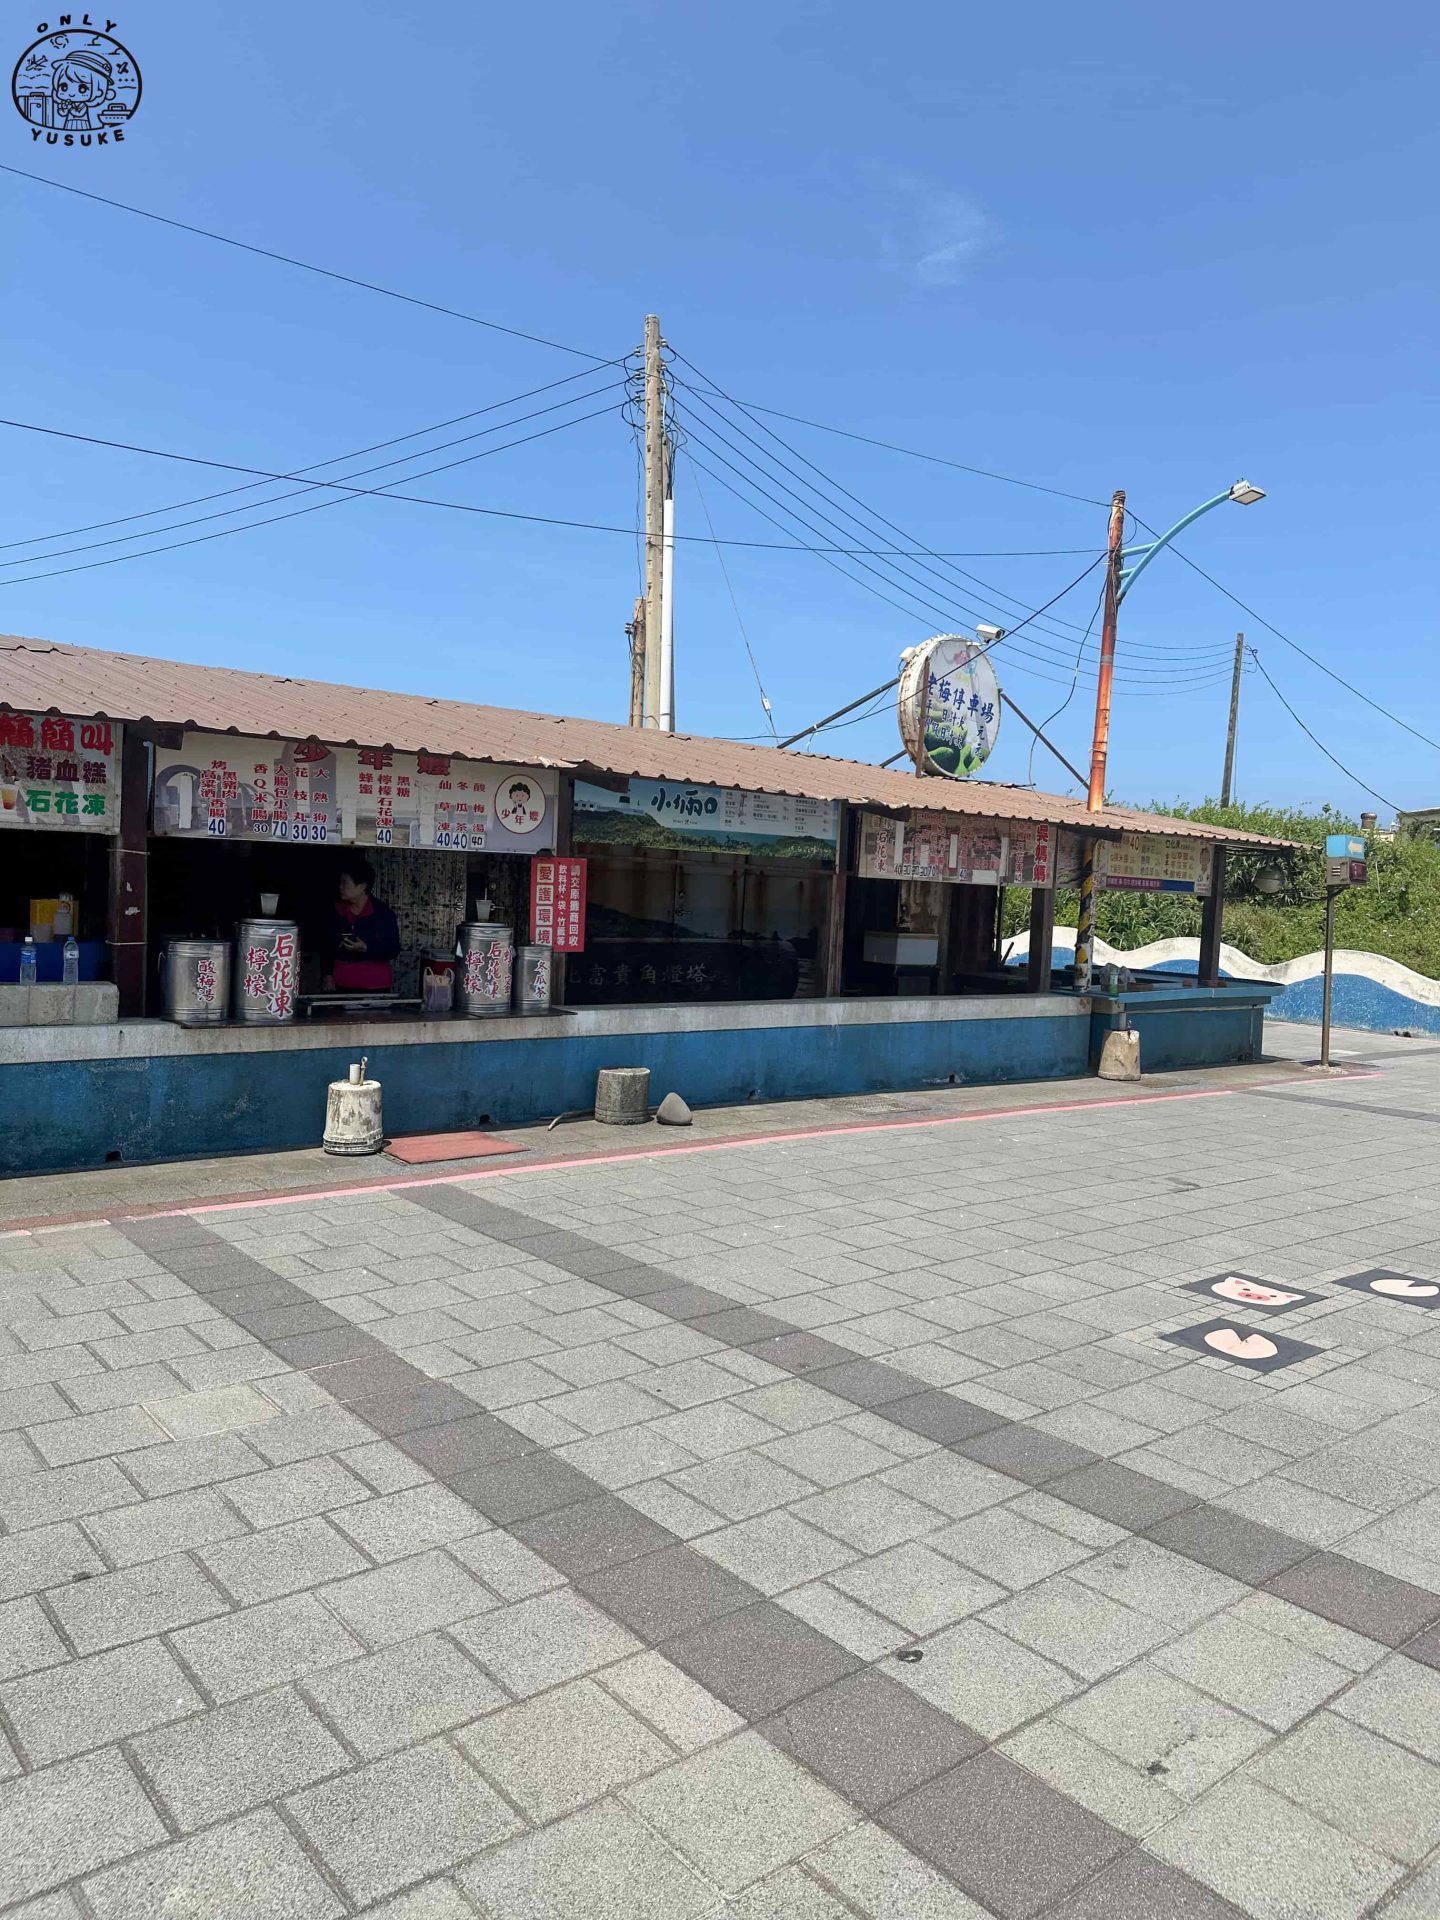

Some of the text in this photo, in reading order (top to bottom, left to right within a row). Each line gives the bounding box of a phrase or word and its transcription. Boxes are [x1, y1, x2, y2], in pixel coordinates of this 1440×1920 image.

[25, 789, 106, 816] 石花凍
[292, 767, 309, 823] 花枝丸
[455, 781, 469, 832] 冬瓜茶
[209, 818, 225, 834] 40
[254, 823, 268, 833] 30
[272, 821, 288, 837] 70
[292, 824, 308, 840] 30
[311, 825, 327, 841] 30
[377, 829, 392, 844] 40
[437, 832, 450, 846] 40
[453, 834, 468, 849] 40
[537, 866, 552, 944] 愛護環境
[197, 959, 217, 1002] 酸梅湯
[244, 946, 269, 997] 檸檬
[267, 933, 294, 1019] 石花凍
[534, 959, 548, 999] 冬瓜茶
